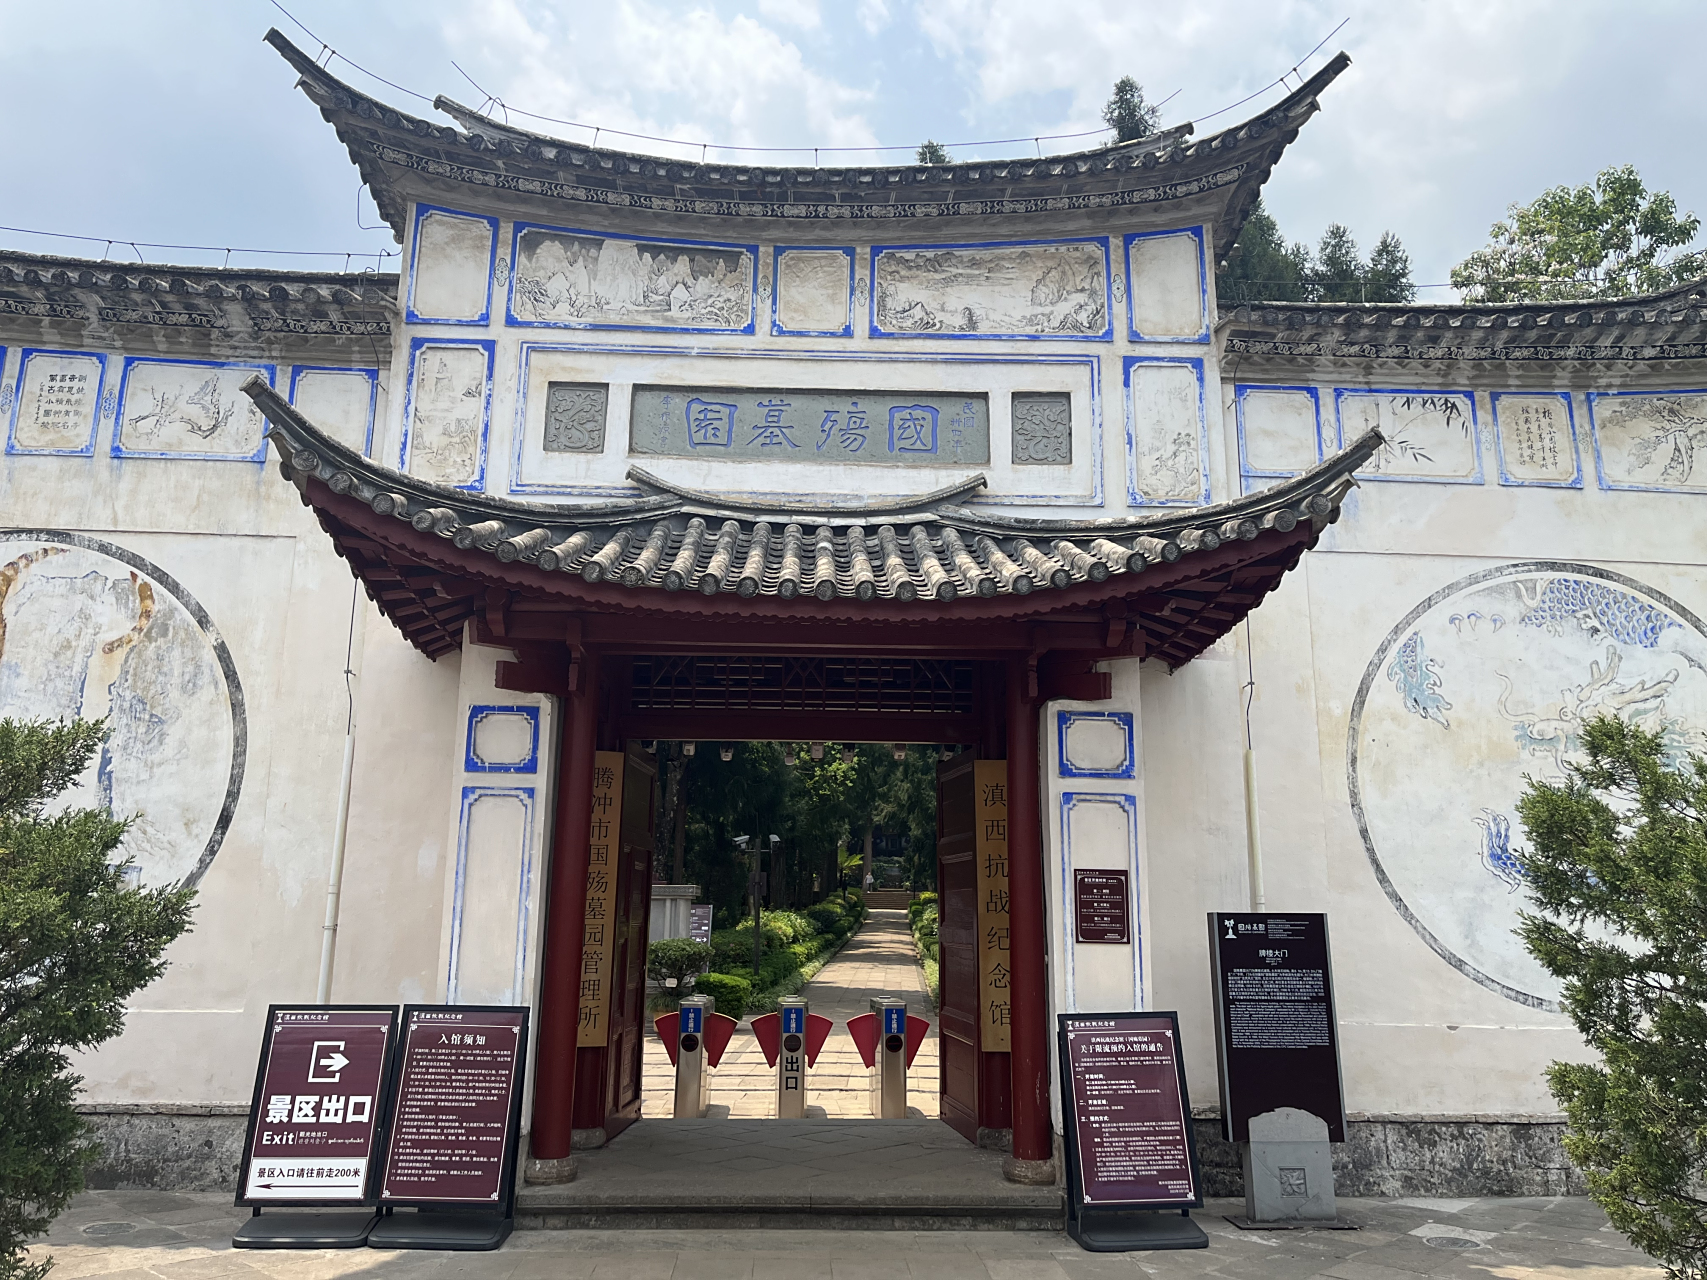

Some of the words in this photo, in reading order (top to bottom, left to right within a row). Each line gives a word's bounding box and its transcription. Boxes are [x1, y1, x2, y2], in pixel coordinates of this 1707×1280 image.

[578, 766, 615, 1029] 腾冲市国殇墓园管理所
[982, 782, 1011, 1027] 滇西抗战纪念馆
[1258, 949, 1288, 958] 牌楼大门
[438, 1033, 486, 1046] 入馆须知
[1080, 1043, 1164, 1054] 关于限流预约入馆的通告
[784, 1055, 800, 1091] 出口
[265, 1094, 373, 1124] 景区出口
[262, 1131, 295, 1145] Exit
[257, 1167, 361, 1178] 景区入口请往前走200米
